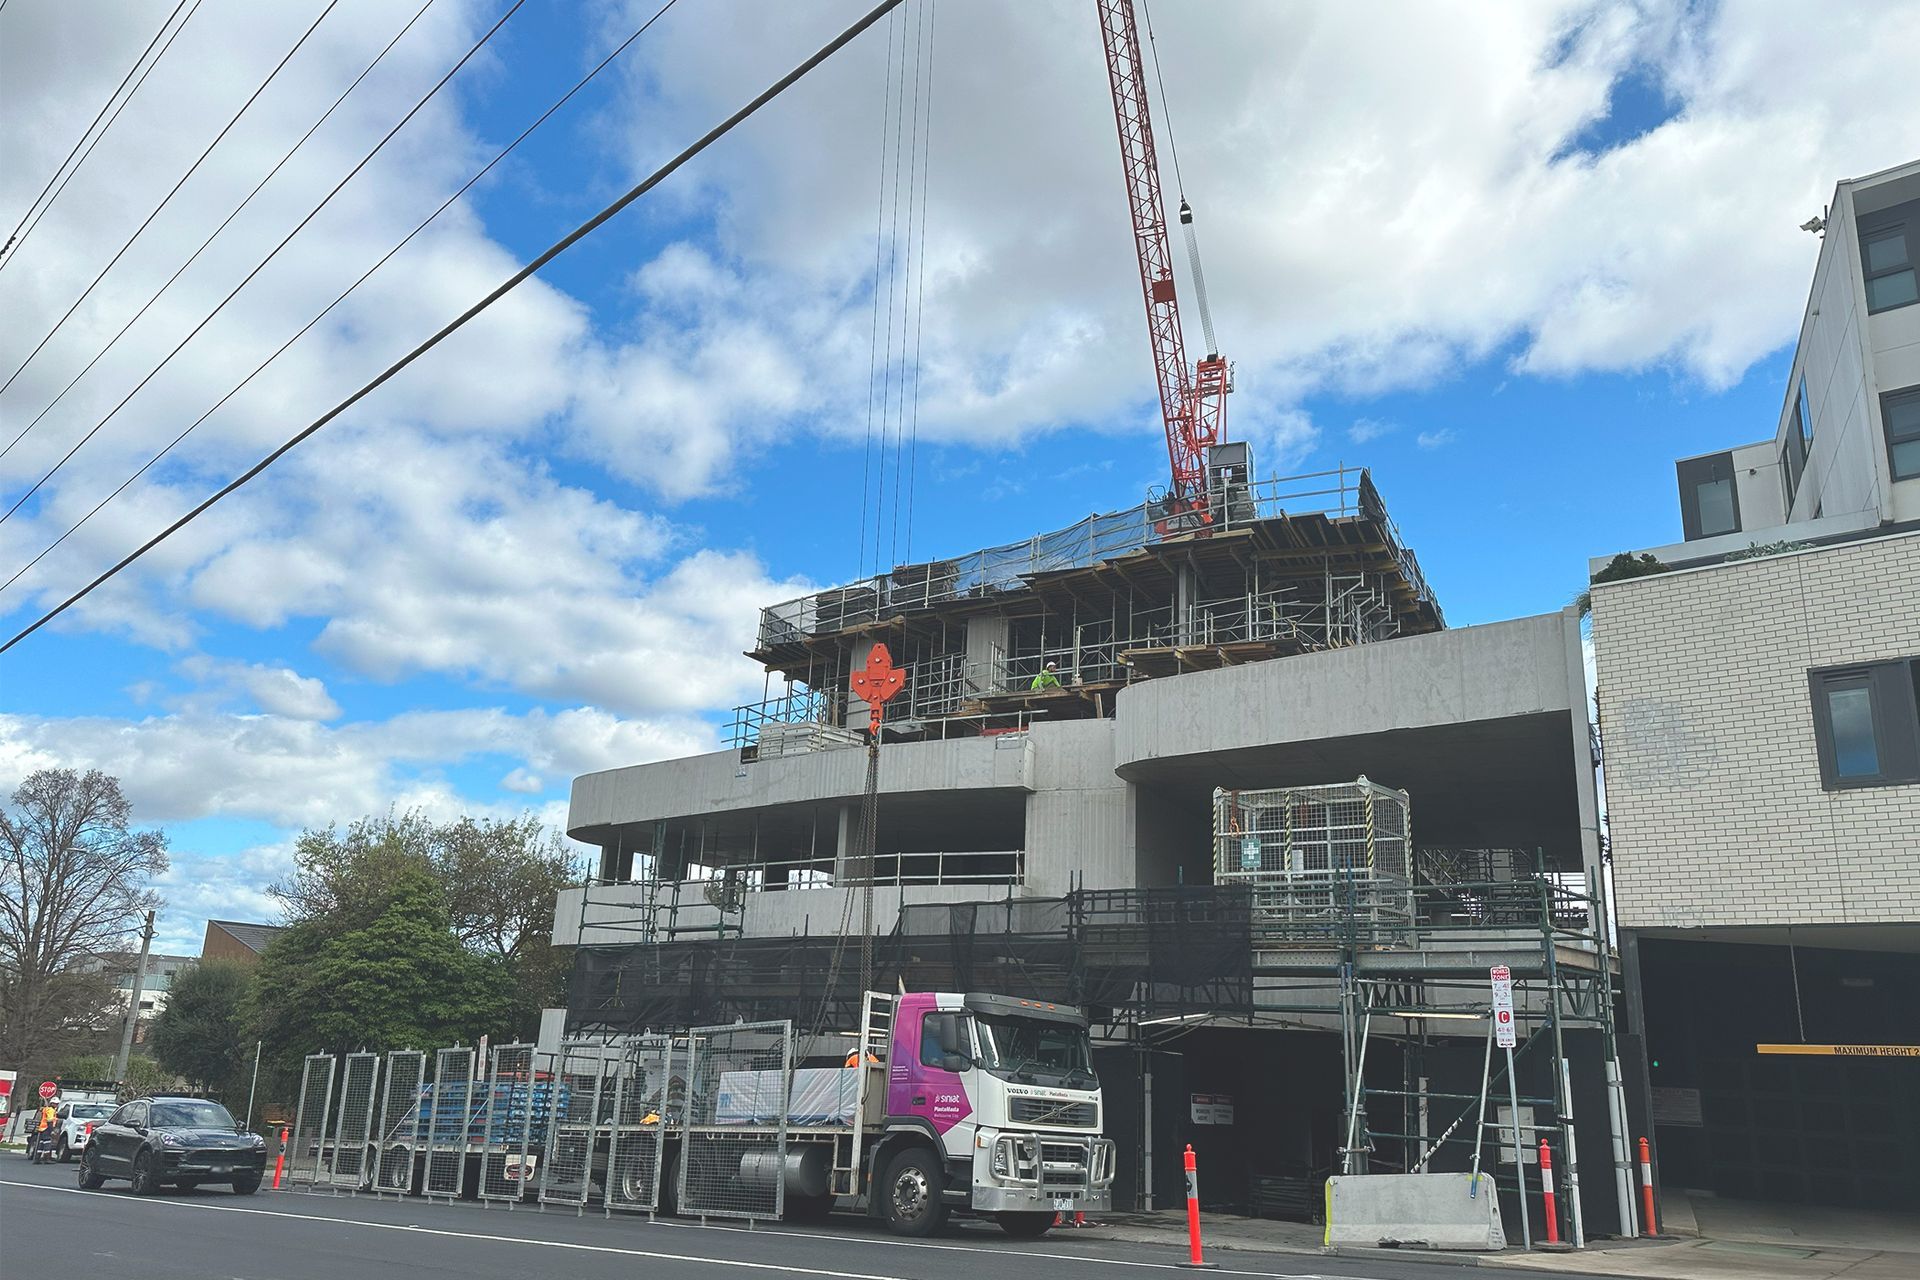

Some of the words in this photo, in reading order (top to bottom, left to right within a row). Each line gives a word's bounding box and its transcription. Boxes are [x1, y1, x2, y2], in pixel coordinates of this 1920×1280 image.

[1834, 1046, 1877, 1055] MAXIMUM
[1880, 1047, 1911, 1056] HEIGHT
[1006, 1087, 1029, 1095] VOLVO
